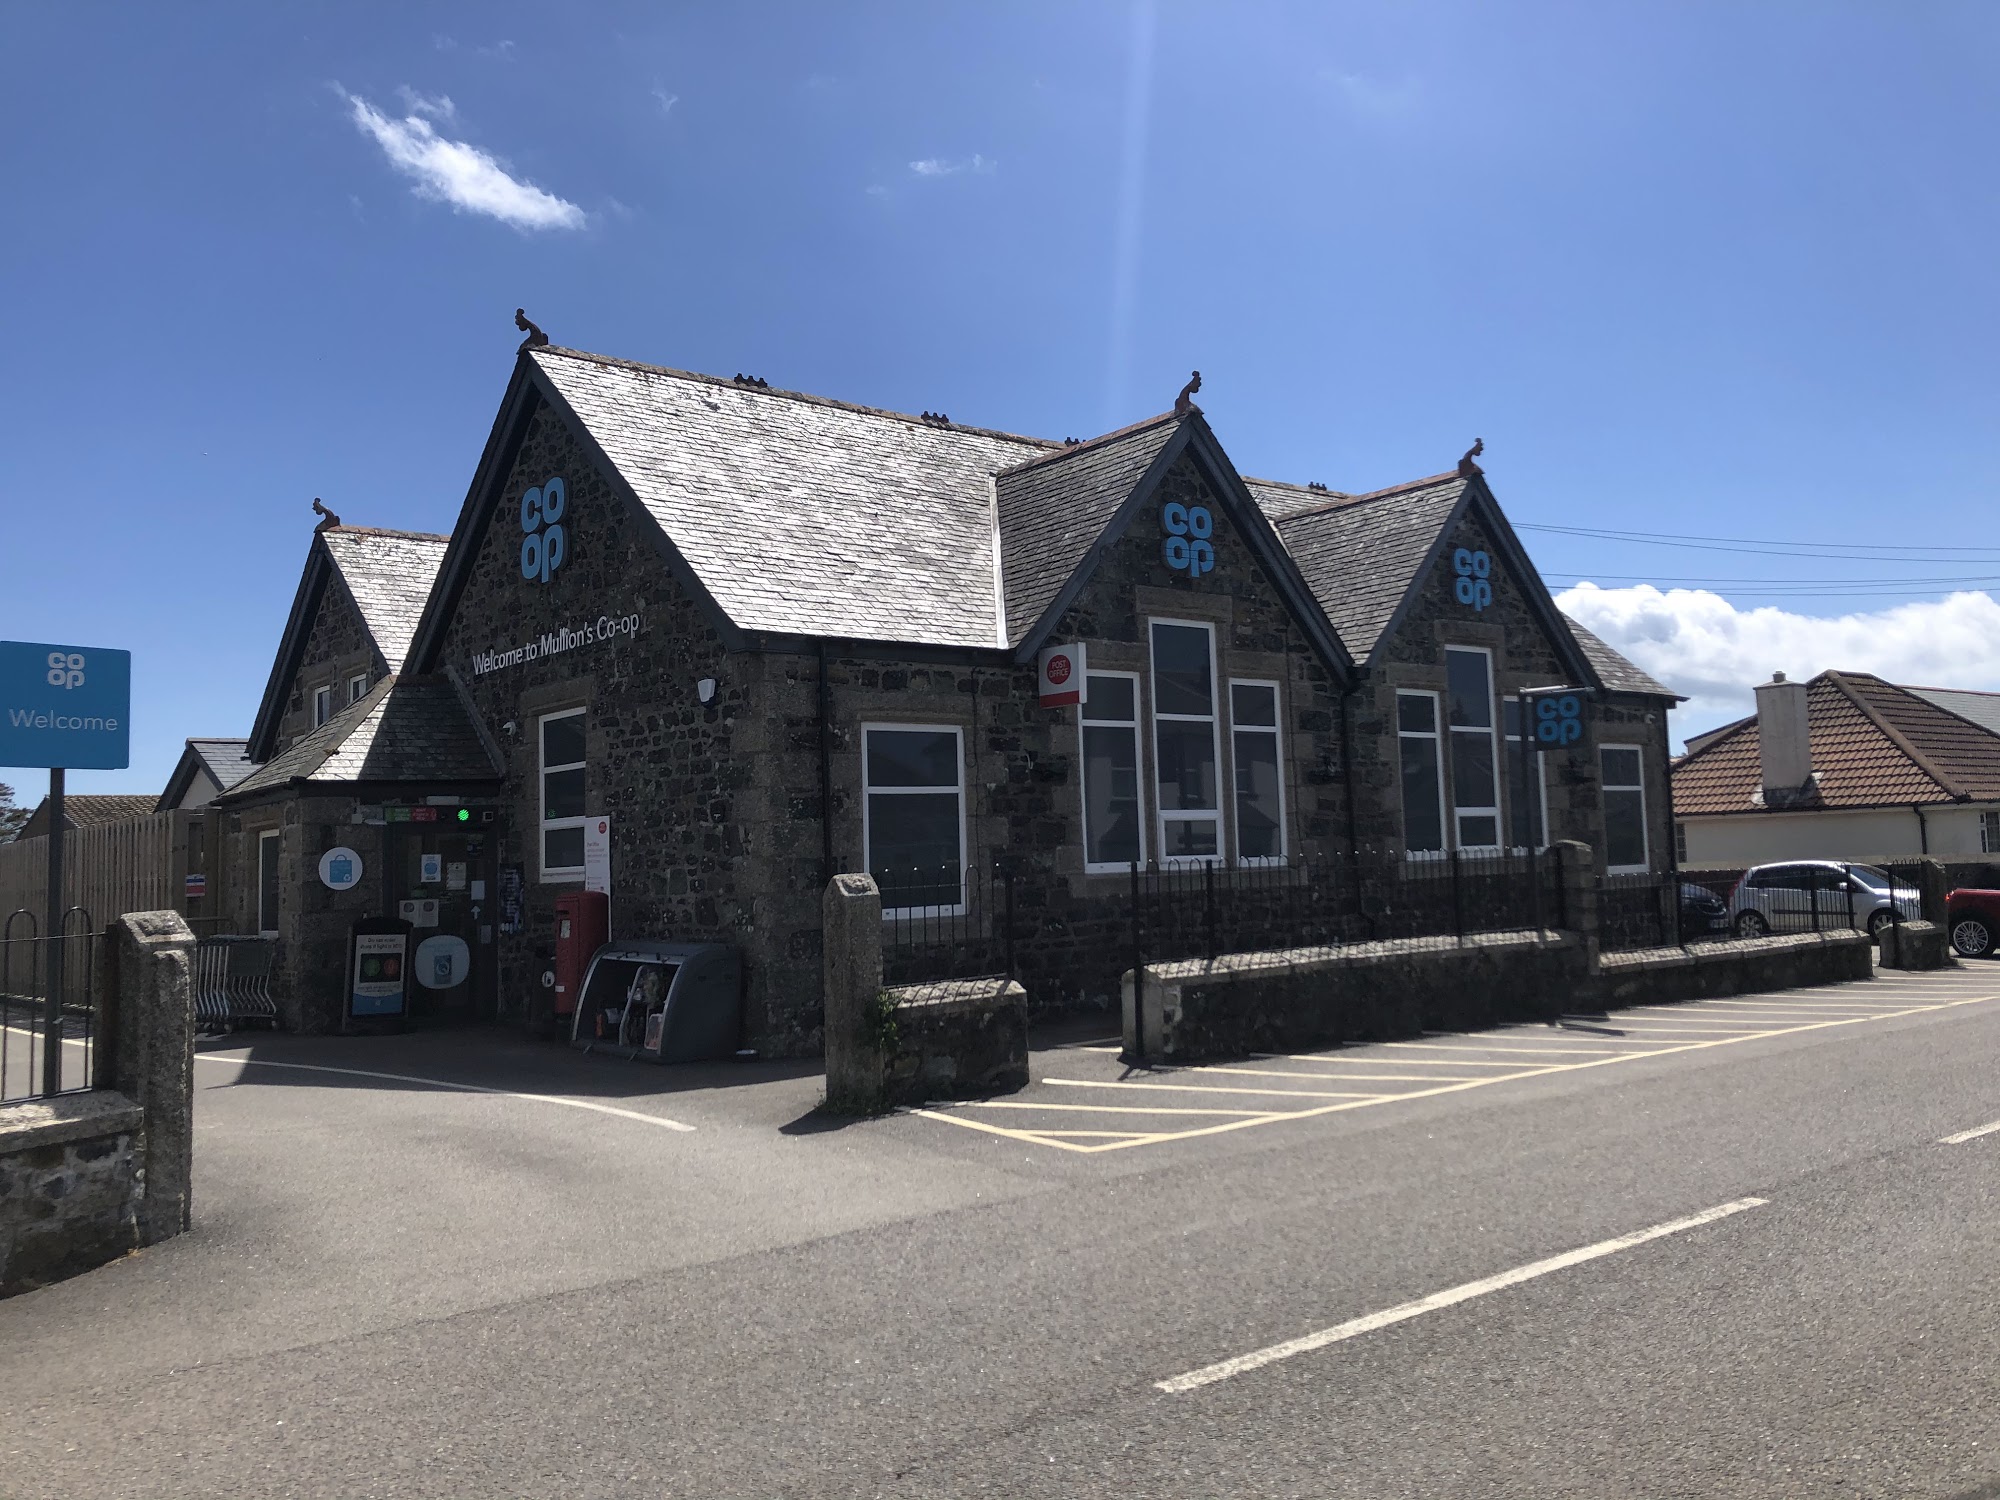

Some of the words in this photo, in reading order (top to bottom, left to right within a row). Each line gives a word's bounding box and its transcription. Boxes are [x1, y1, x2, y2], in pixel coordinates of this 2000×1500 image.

[472, 648, 523, 675] Welcome
[526, 642, 538, 661] to
[540, 621, 594, 657] Mullion's
[596, 613, 640, 640] Co-op
[1051, 660, 1067, 669] POST
[1048, 668, 1069, 678] OFFICE
[8, 708, 118, 731] Welcome
